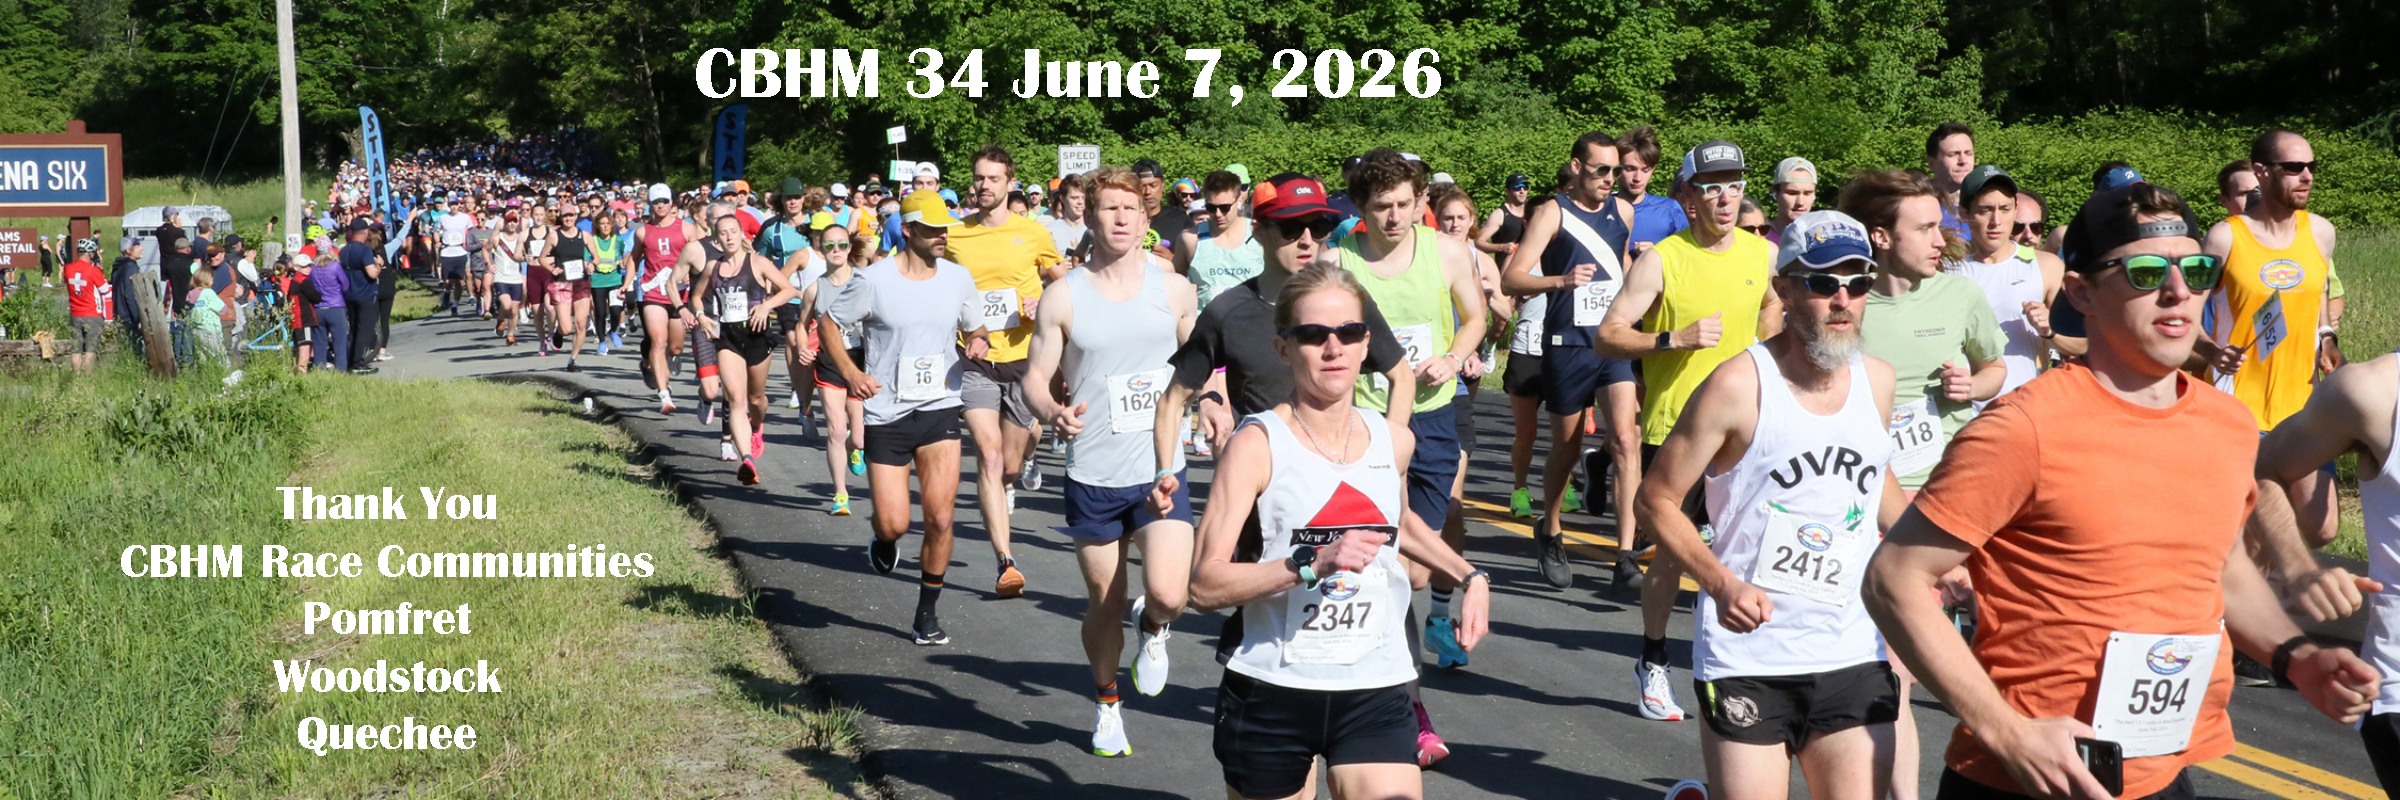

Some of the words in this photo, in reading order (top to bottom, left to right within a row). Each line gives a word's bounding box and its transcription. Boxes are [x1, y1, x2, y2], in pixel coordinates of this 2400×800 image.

[721, 111, 737, 180] STA
[1063, 151, 1096, 160] SPEED
[0, 160, 39, 191] NA
[47, 160, 88, 191] SIX
[1066, 162, 1092, 170] LIMIT
[1209, 267, 1251, 276] BOSTON
[983, 303, 1008, 317] 224
[1582, 294, 1613, 311] 1545
[915, 371, 932, 385] 16
[1119, 389, 1162, 413] 1620
[1768, 445, 1878, 496] UVRC
[1771, 545, 1843, 586] 2412
[1301, 601, 1372, 632] 2347
[2127, 677, 2190, 715] 594
